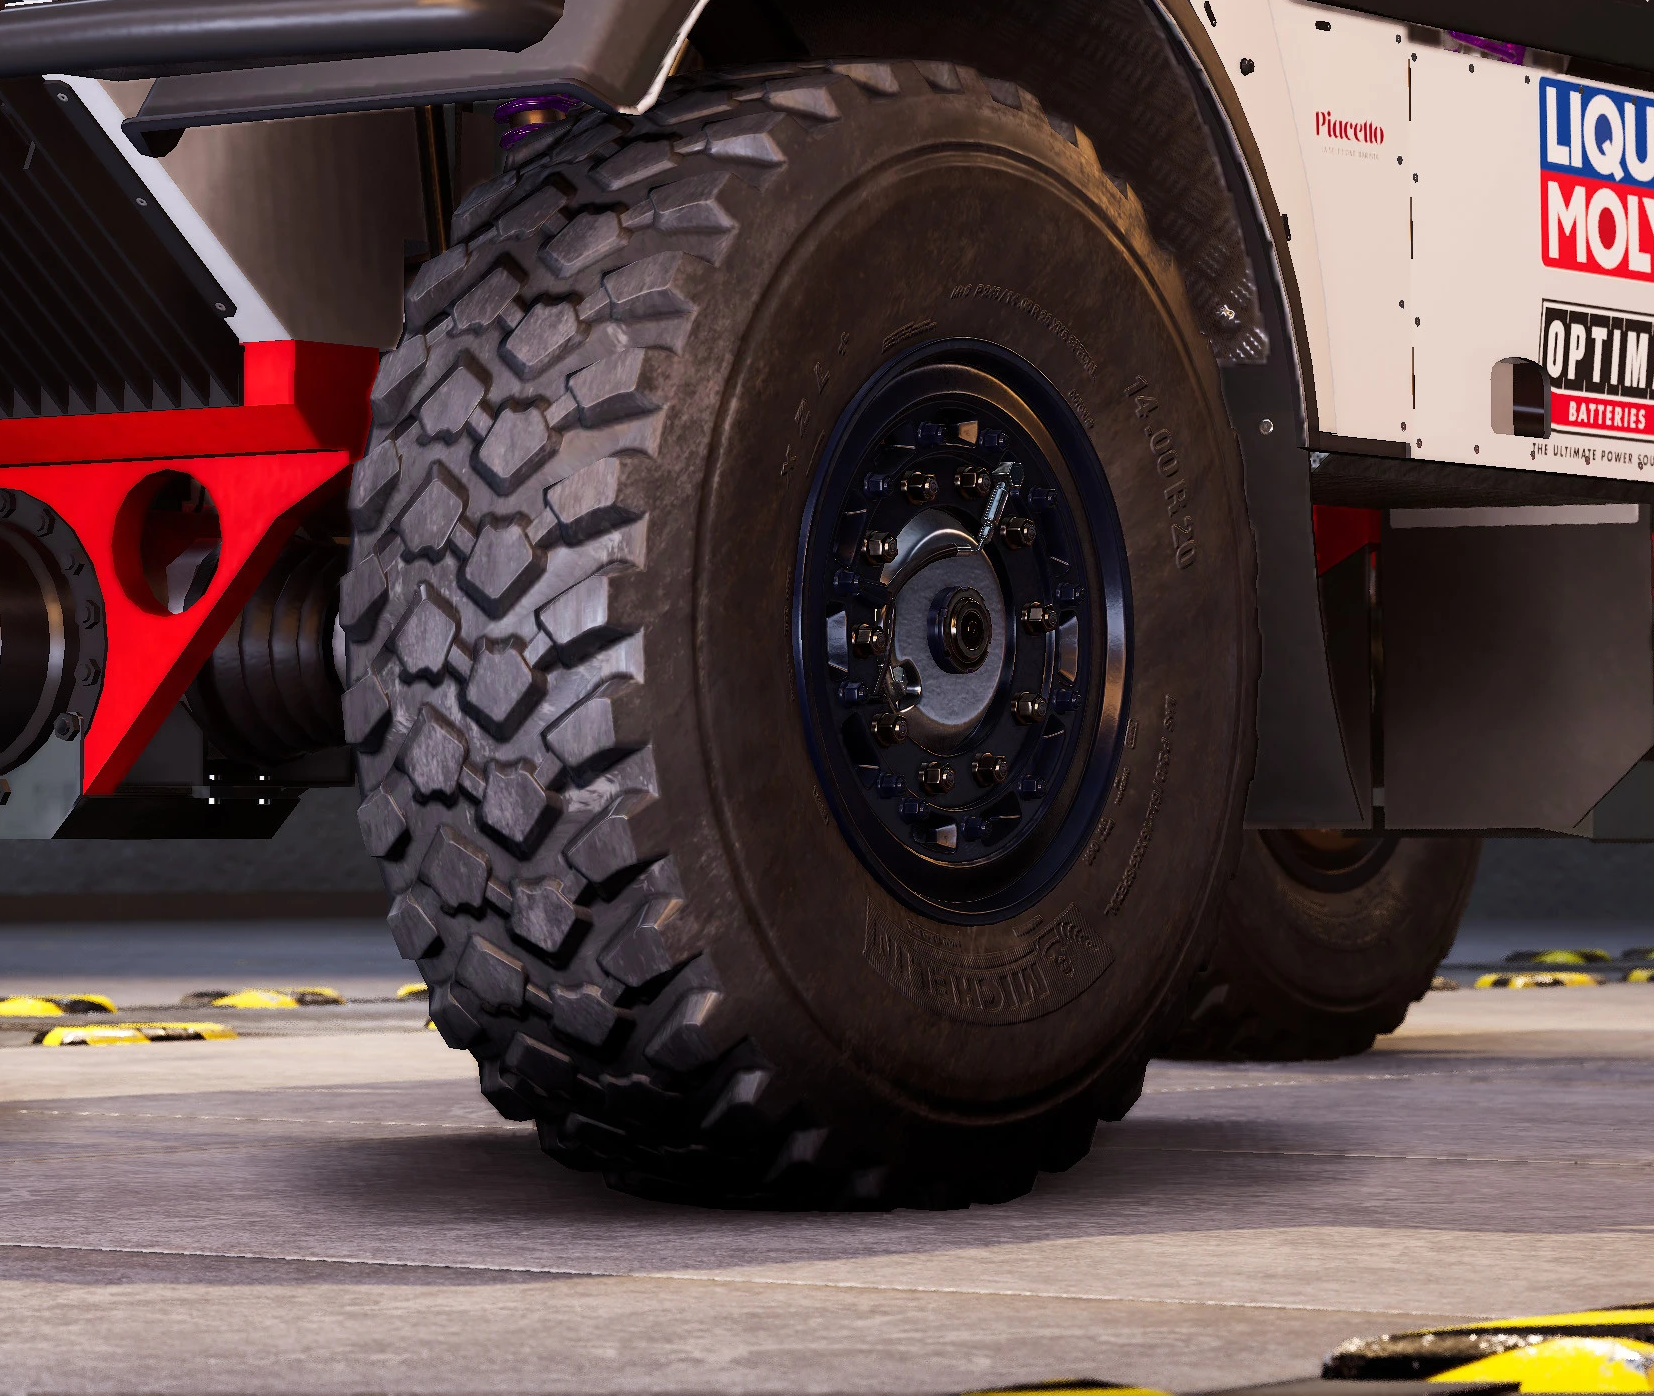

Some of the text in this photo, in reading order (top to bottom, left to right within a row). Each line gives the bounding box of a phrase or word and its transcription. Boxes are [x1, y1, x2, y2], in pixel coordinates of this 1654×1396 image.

[1568, 400, 1647, 430] BATTERIES
[1553, 445, 1597, 461] ULTIMATE
[1601, 450, 1633, 464] POWER
[872, 923, 1050, 1013] MICHELIN
